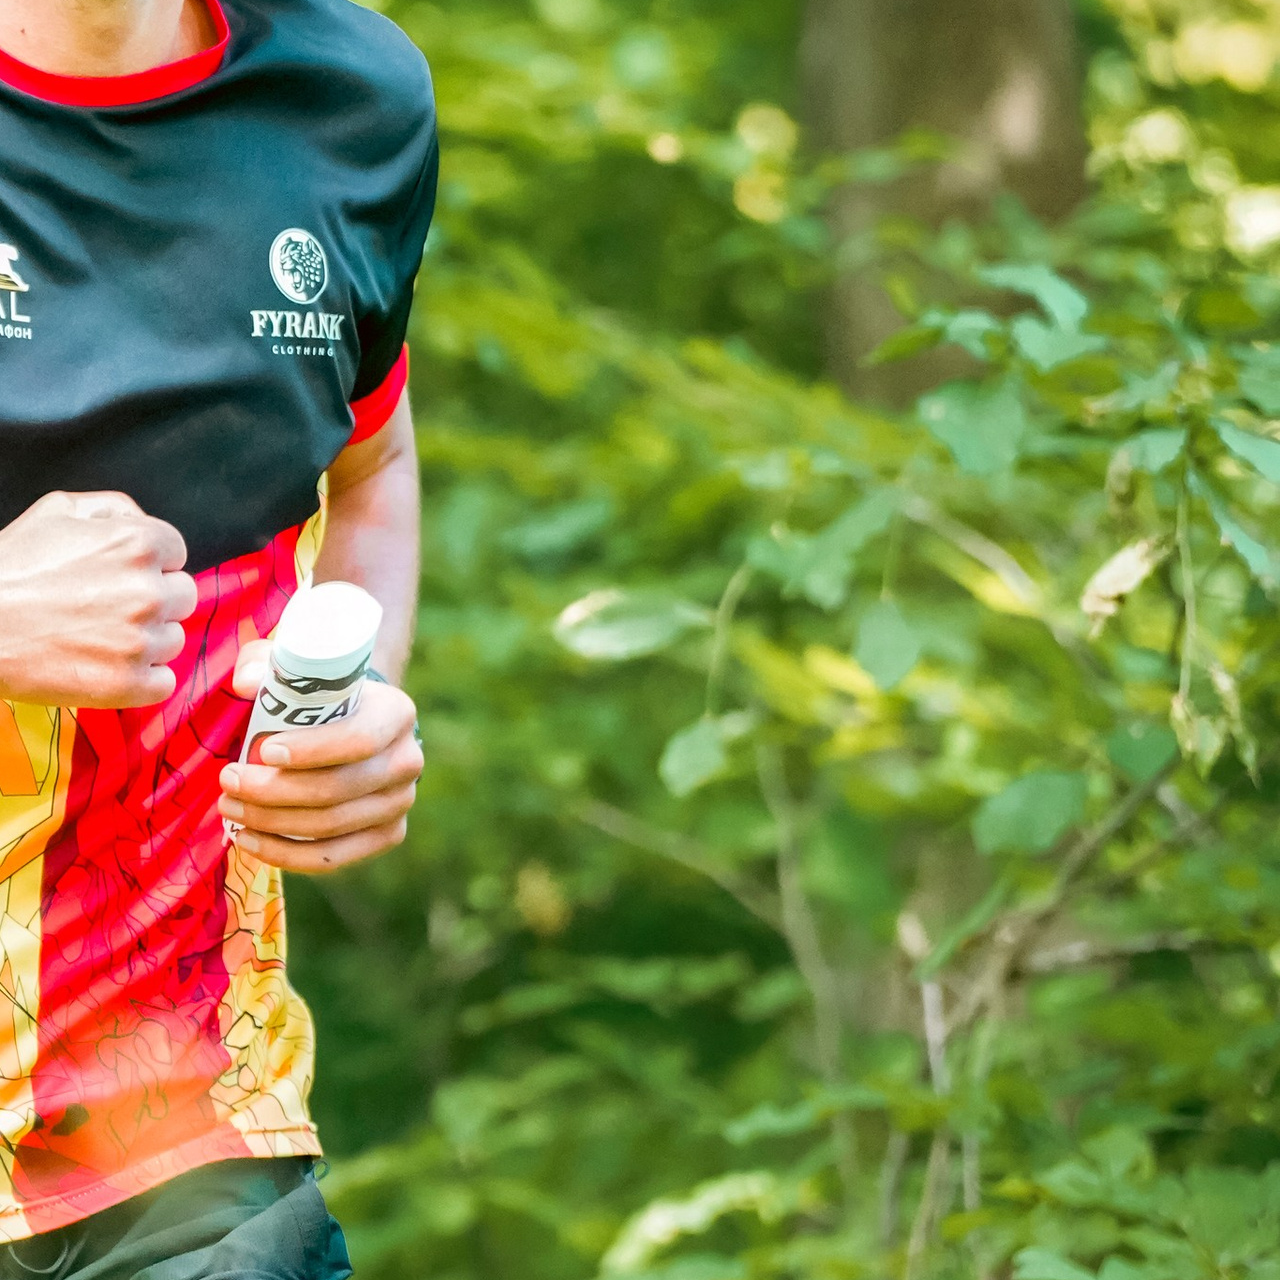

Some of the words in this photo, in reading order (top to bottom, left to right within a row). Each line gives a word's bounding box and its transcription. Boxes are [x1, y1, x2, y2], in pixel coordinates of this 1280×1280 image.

[250, 310, 345, 340] FYRANK
[272, 345, 334, 357] CLOTHING
[259, 686, 362, 726] OGA
